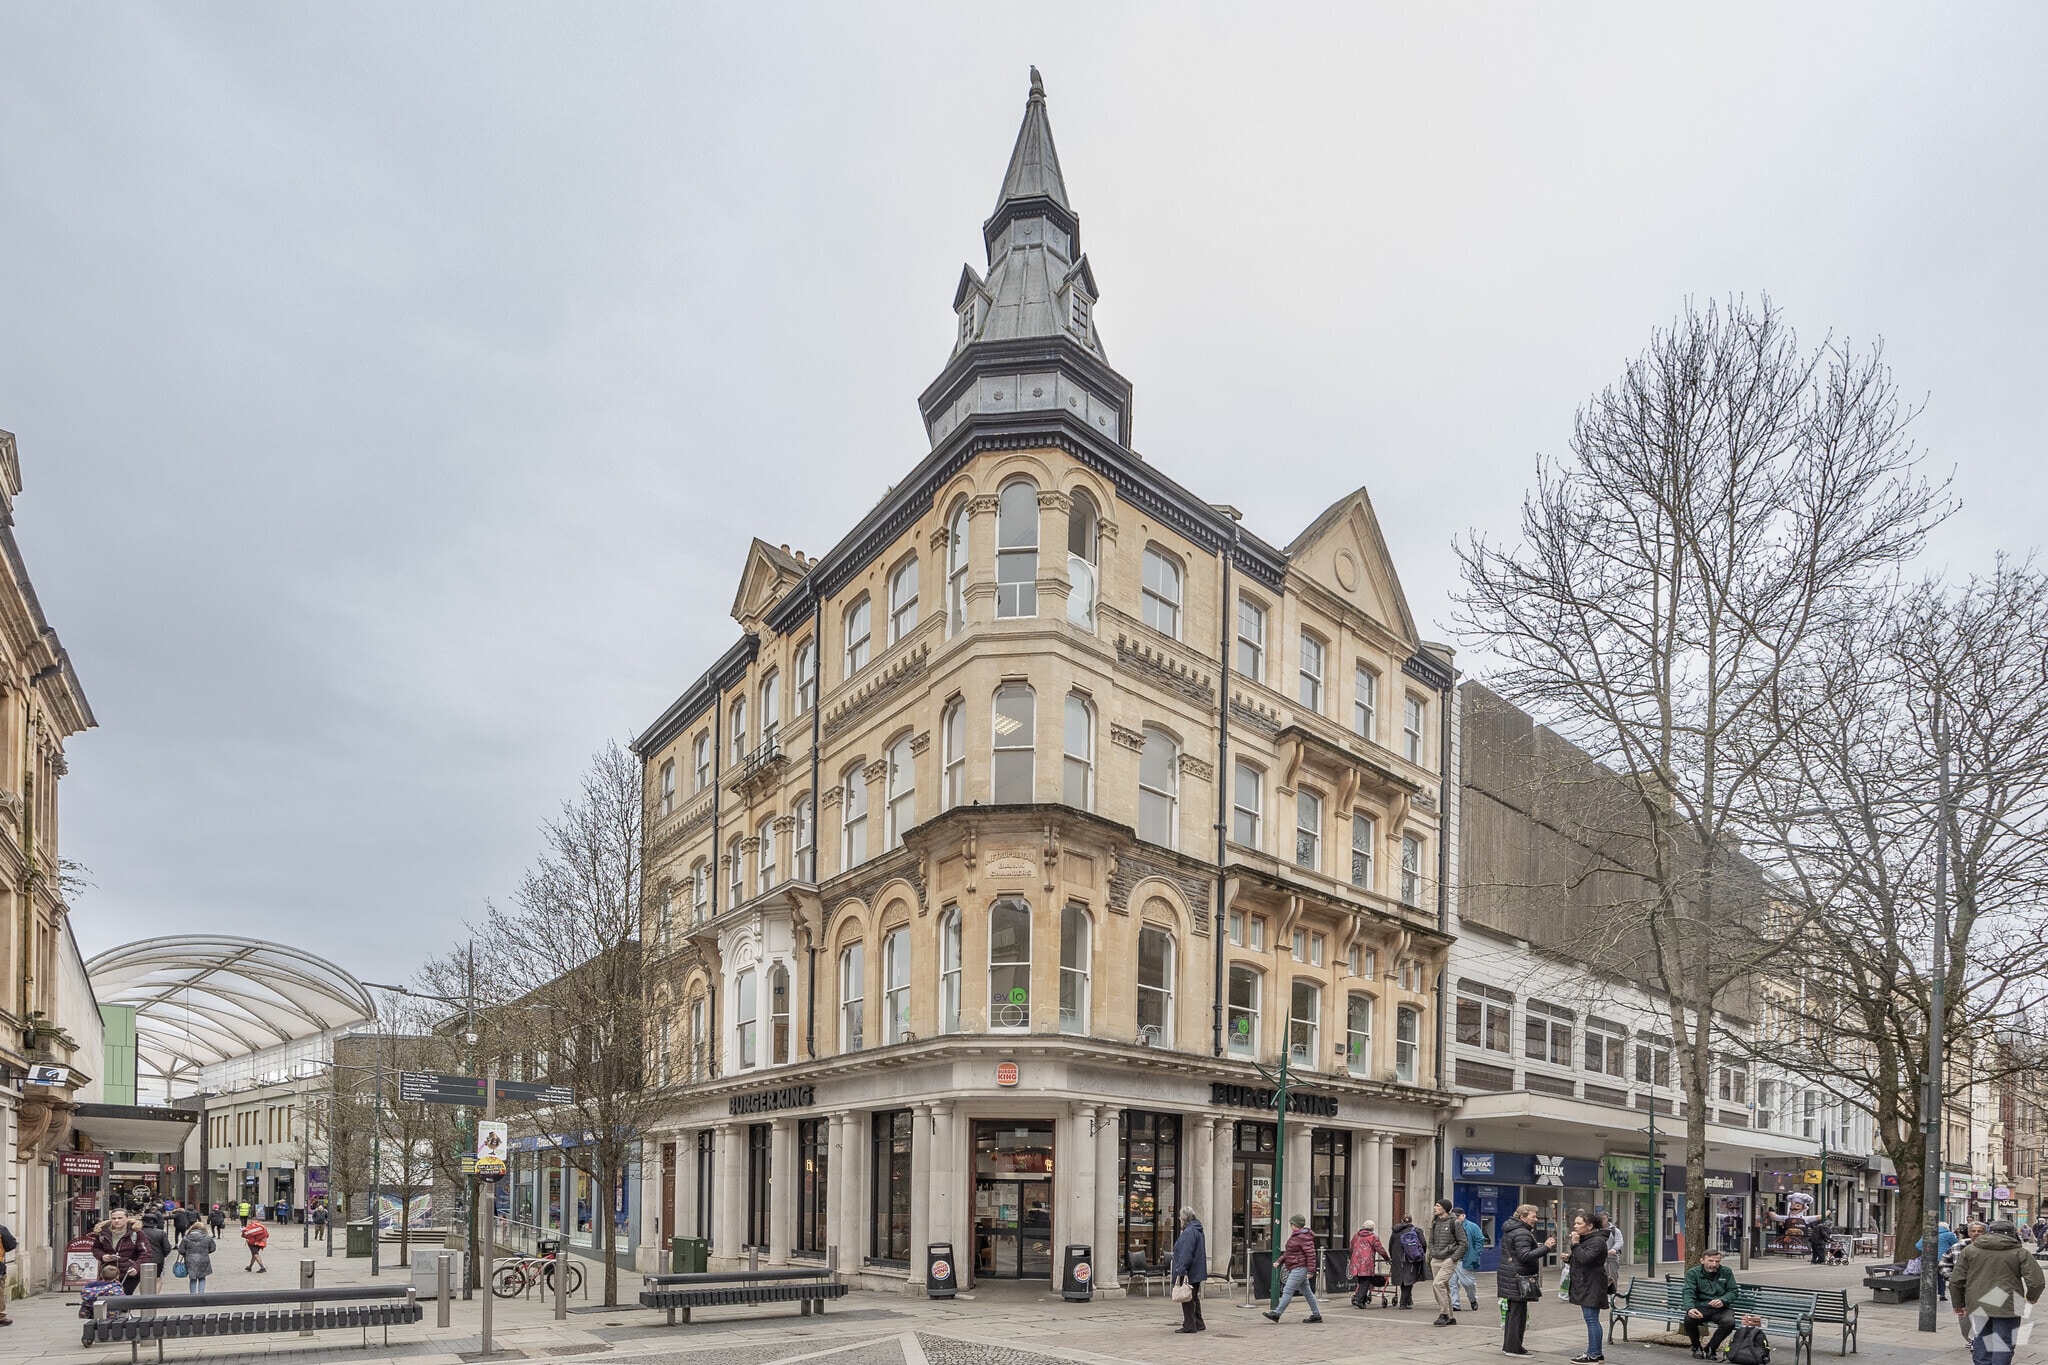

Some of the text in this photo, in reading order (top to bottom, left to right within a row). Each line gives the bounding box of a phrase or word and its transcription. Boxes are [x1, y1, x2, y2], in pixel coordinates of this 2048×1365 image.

[985, 850, 1036, 866] METROPOLITAN
[994, 990, 1023, 1001] evlo
[729, 1085, 812, 1114] BURGER KING
[1295, 1093, 1338, 1117] KING
[1535, 1164, 1564, 1177] HALIFAX
[1704, 1176, 1733, 1189] perative bank
[71, 1240, 94, 1248] TIMPSO
